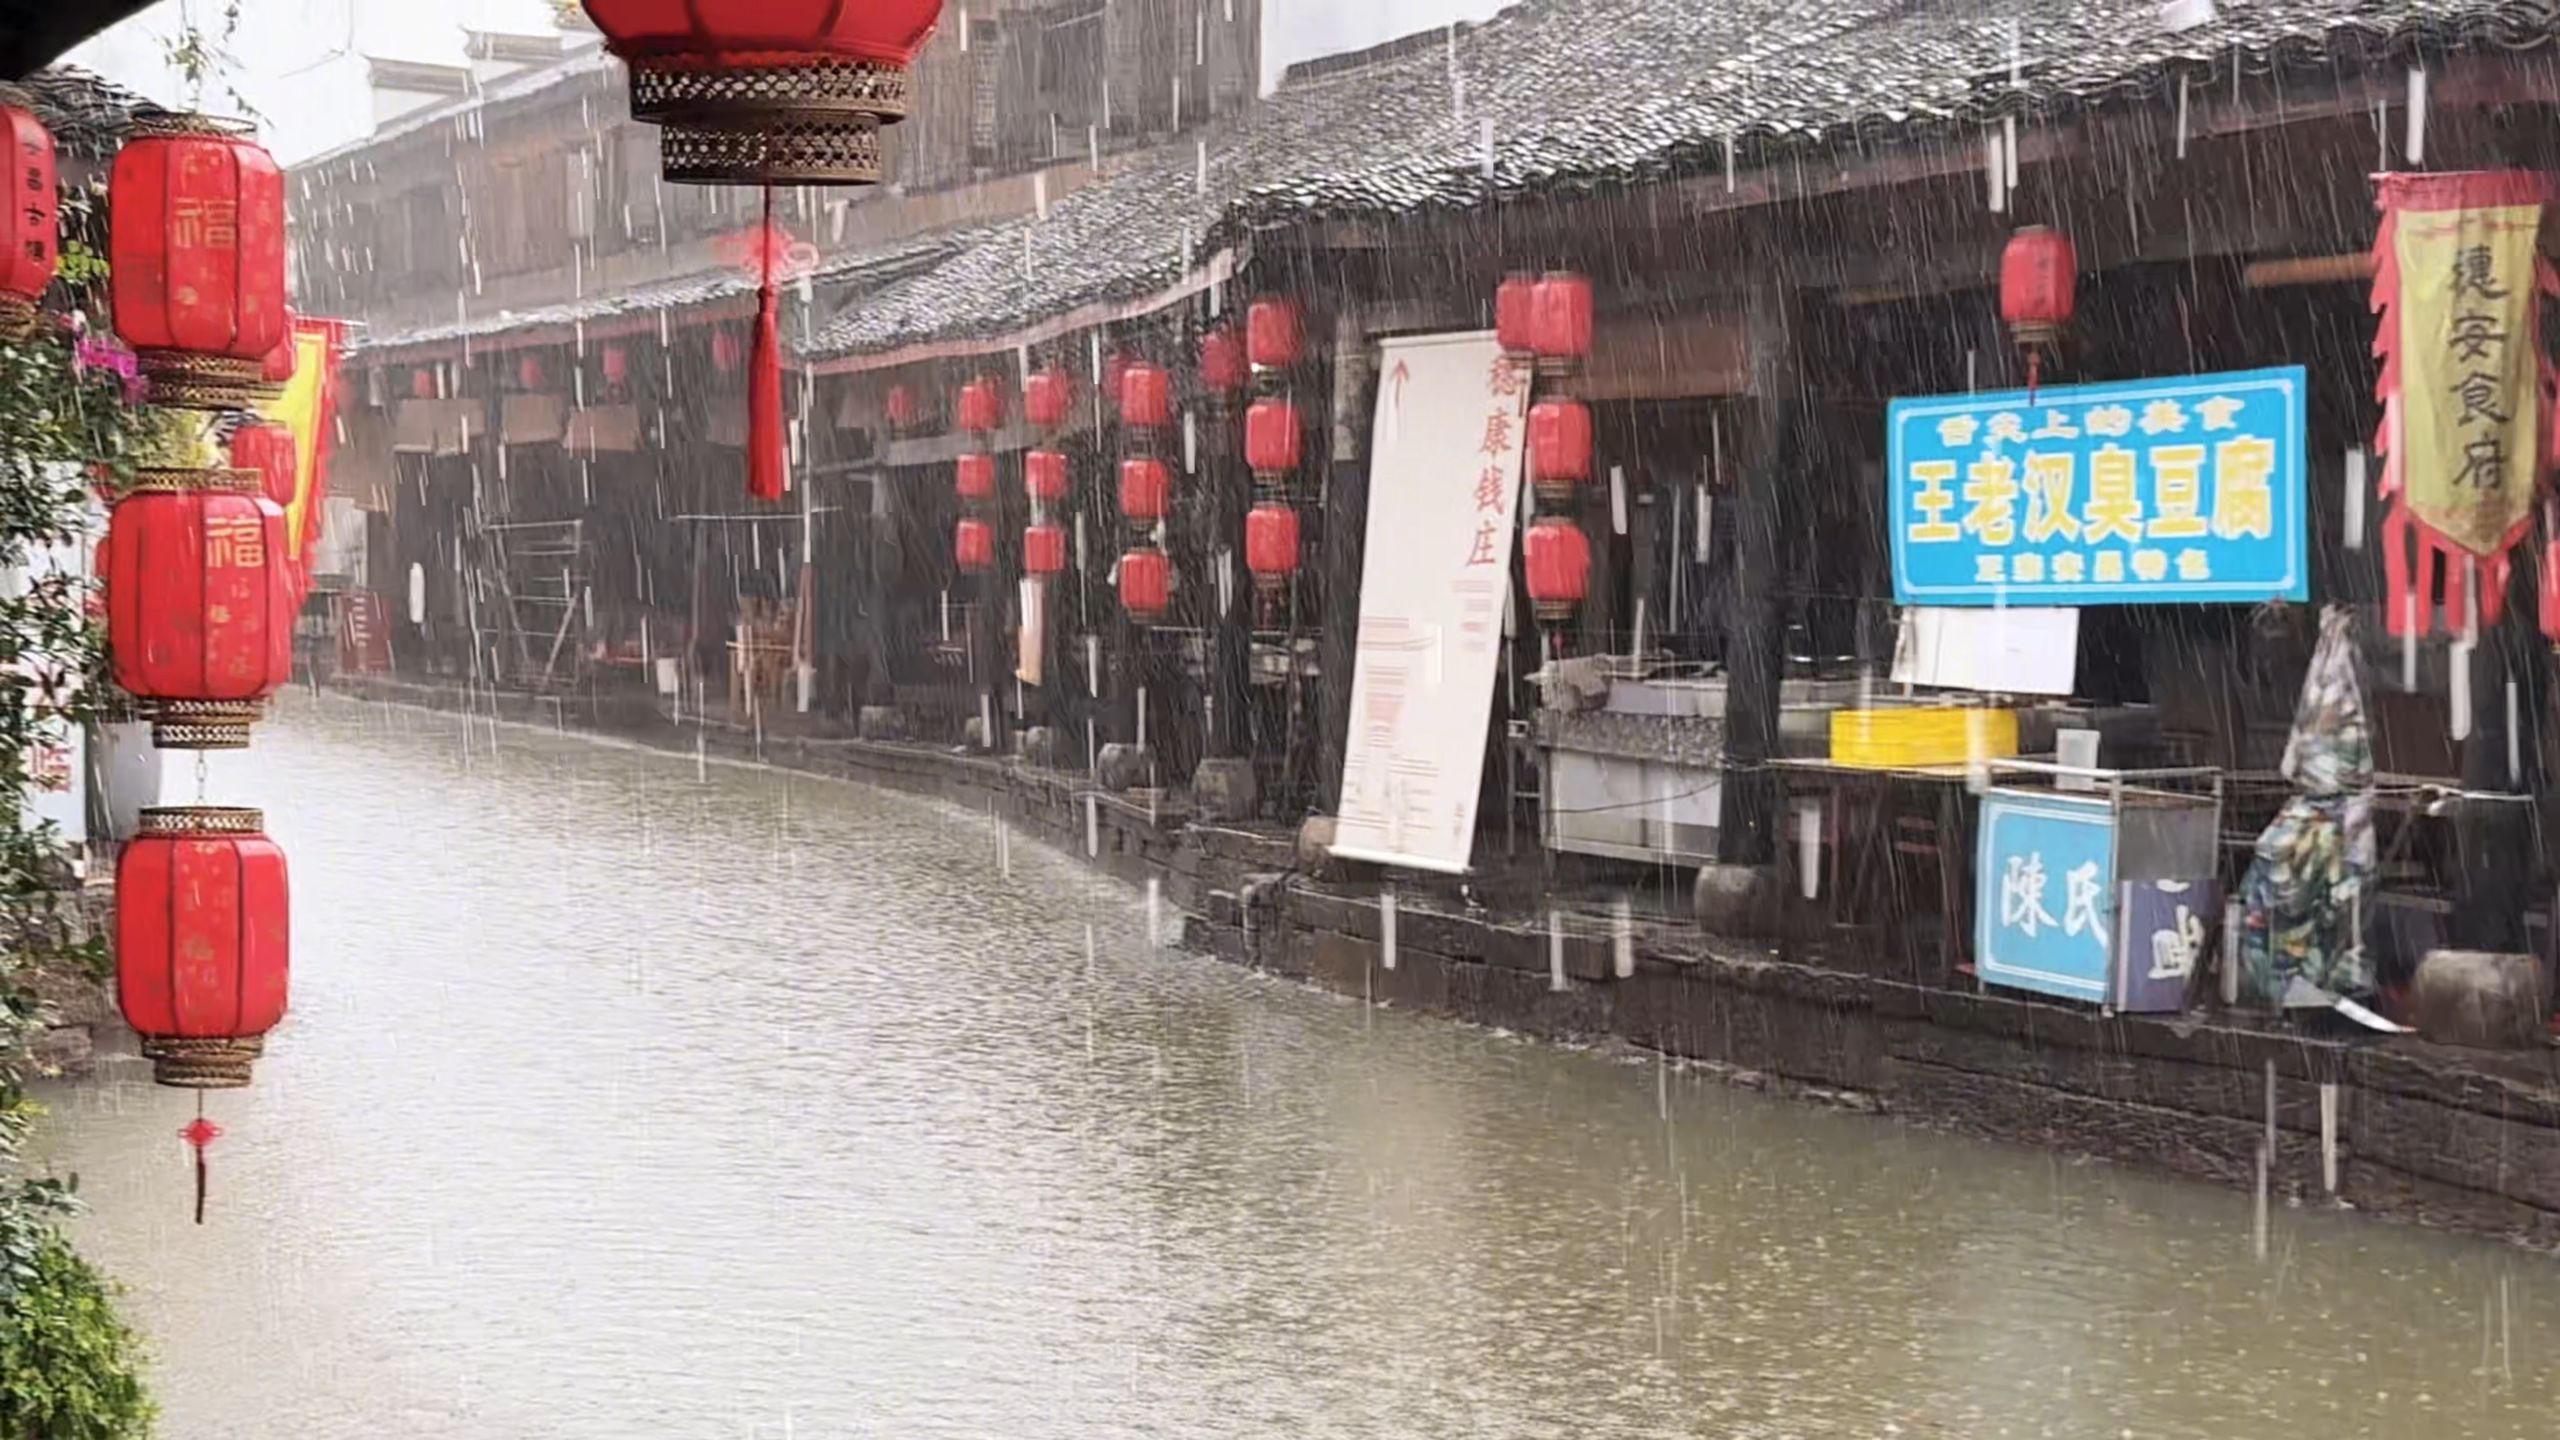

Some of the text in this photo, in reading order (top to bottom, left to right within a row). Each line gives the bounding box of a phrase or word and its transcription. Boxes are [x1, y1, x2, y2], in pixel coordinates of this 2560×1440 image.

[174, 197, 236, 248] 福
[1907, 433, 2276, 546] 王老汉臭豆腐
[206, 513, 265, 568] 福
[2000, 851, 2109, 948] 陳氏
